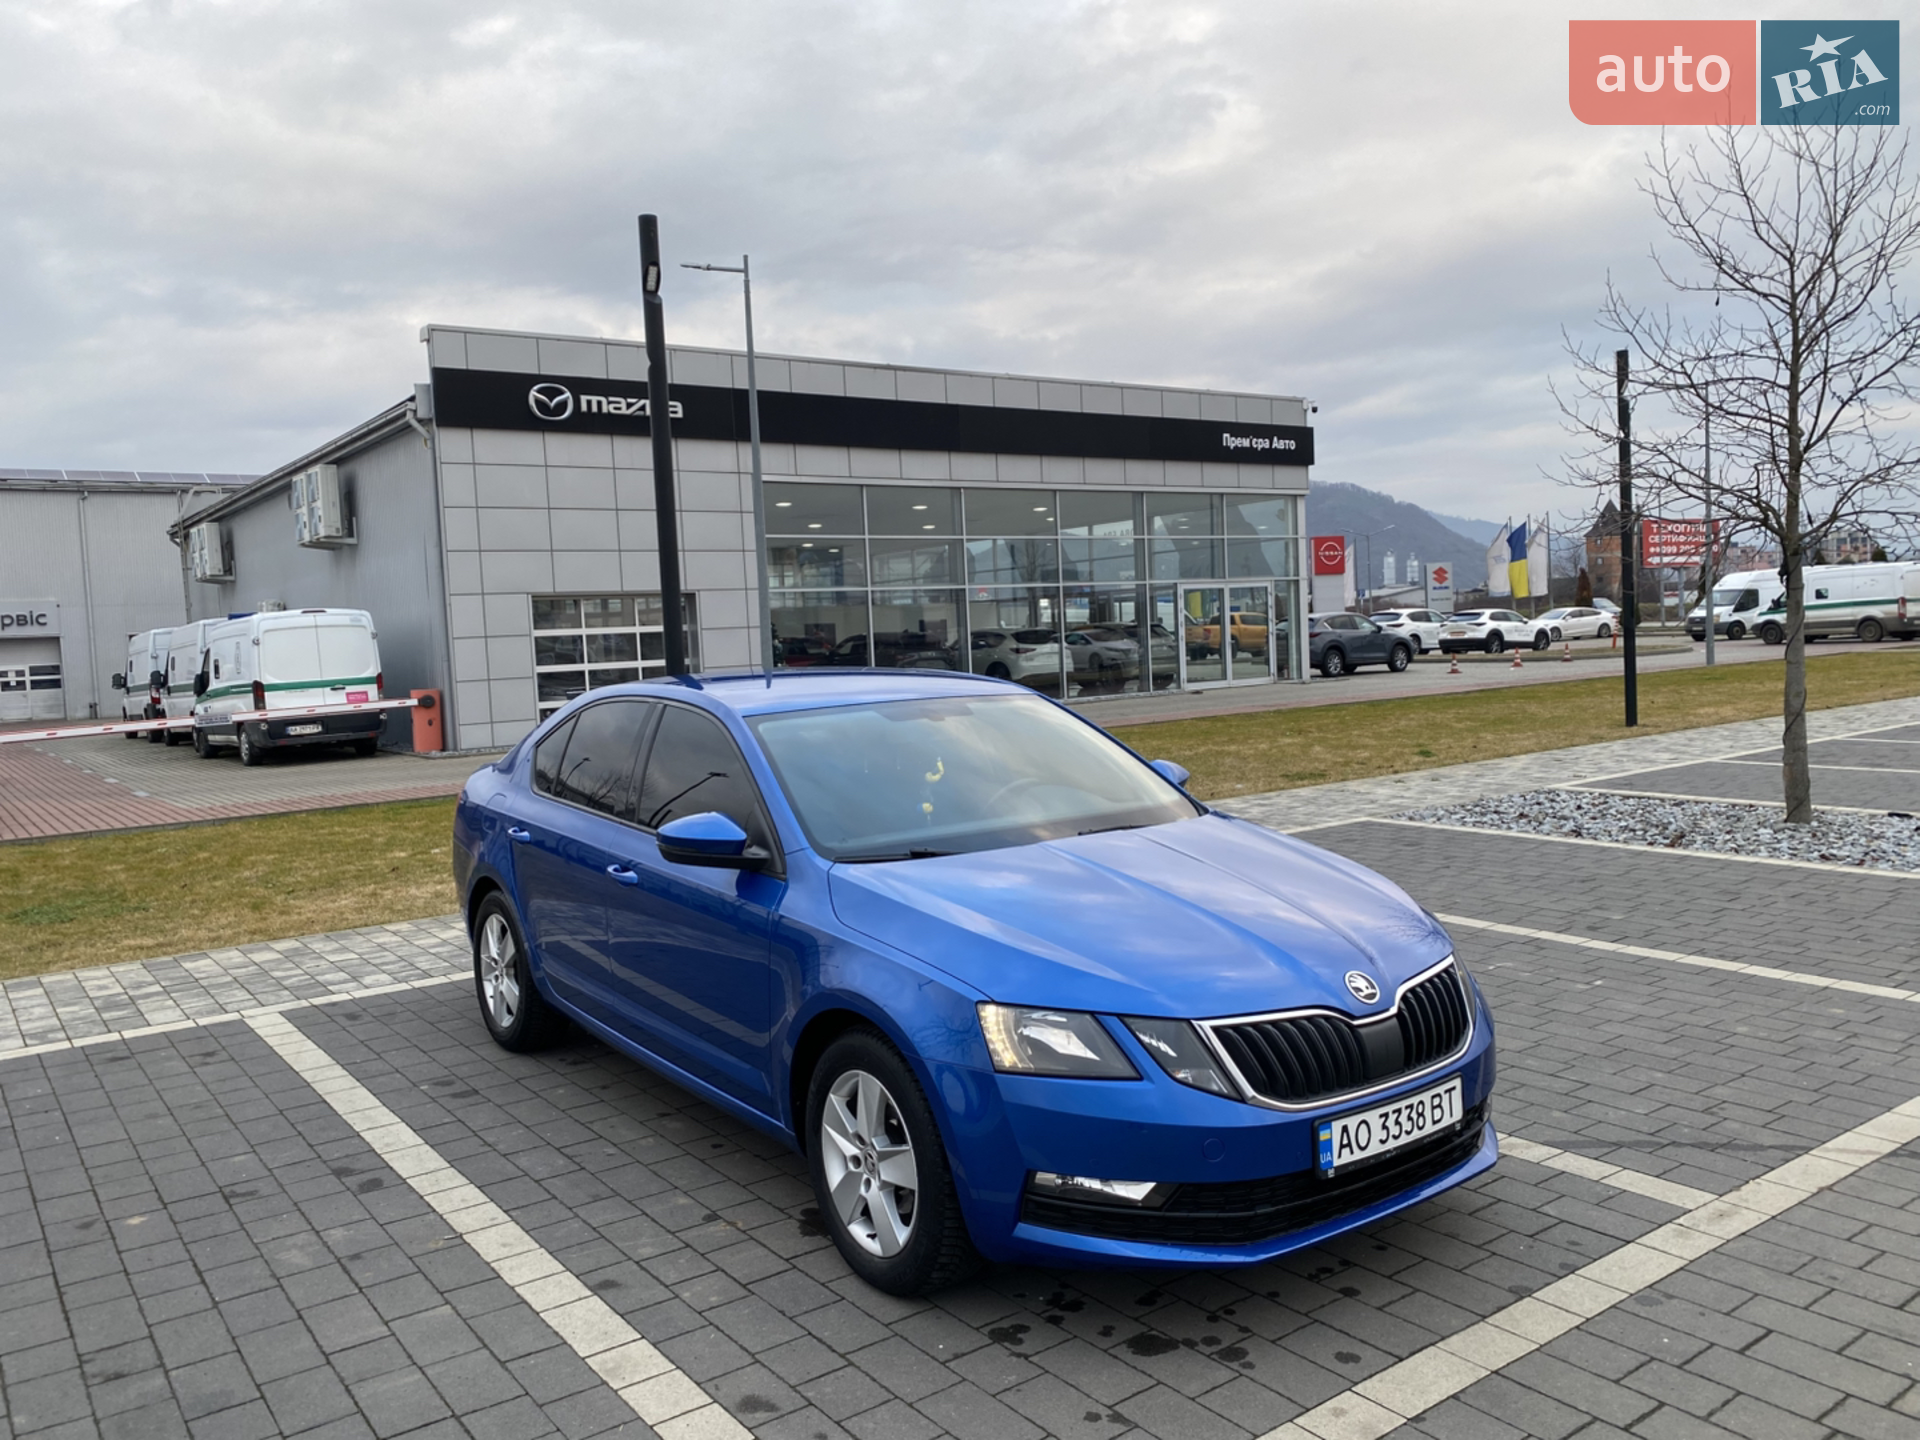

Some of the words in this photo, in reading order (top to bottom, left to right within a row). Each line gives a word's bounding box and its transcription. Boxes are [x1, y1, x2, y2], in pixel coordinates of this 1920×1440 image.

[579, 394, 684, 419] maza
[1271, 435, 1297, 451] Авто
[1337, 1118, 1372, 1160] AO
[1378, 1099, 1427, 1146] 3338
[1430, 1085, 1457, 1127] BT
[1319, 1150, 1334, 1165] UA
